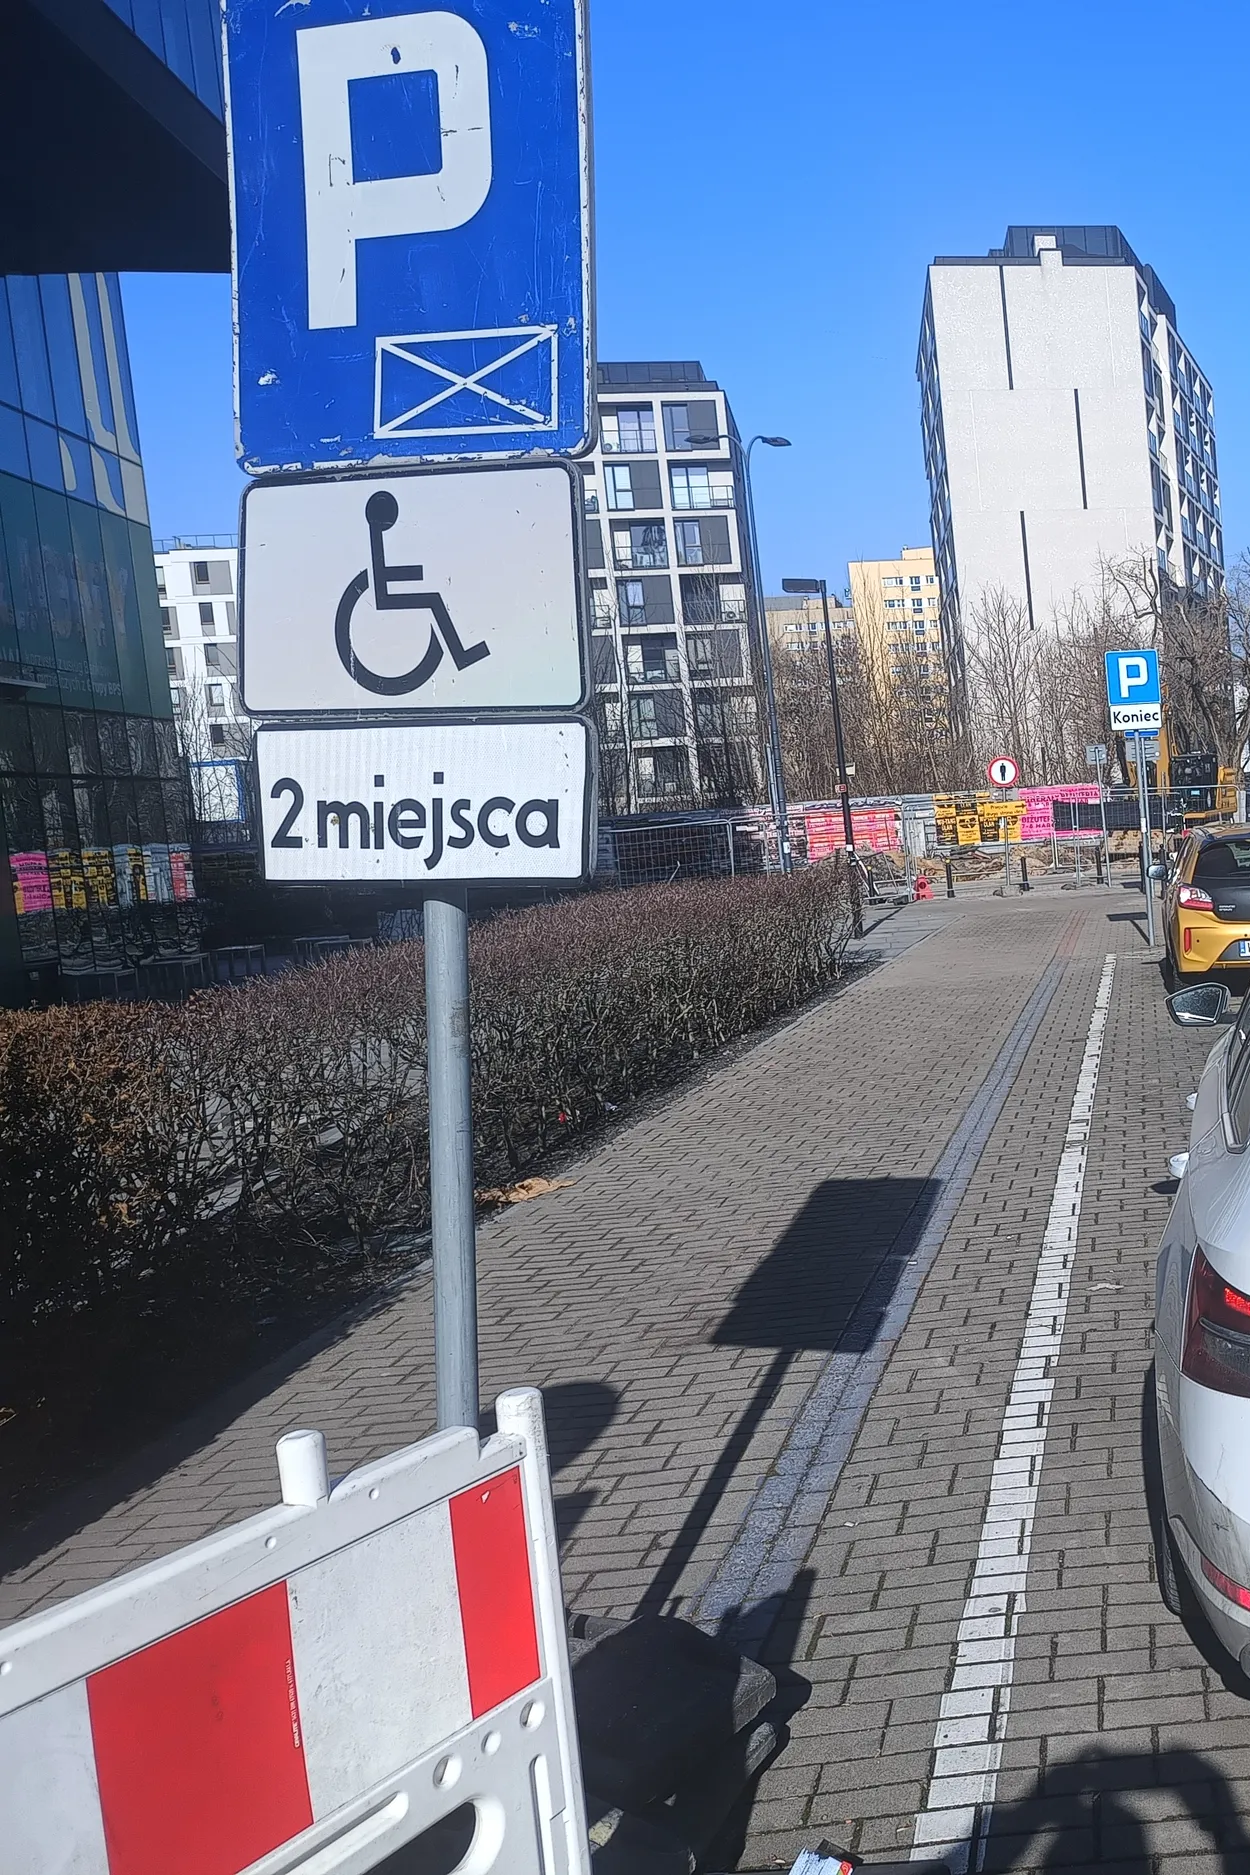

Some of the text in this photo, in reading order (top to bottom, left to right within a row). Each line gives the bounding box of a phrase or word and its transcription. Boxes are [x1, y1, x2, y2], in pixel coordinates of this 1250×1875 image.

[296, 10, 493, 330] P
[1118, 657, 1148, 698] P
[1113, 709, 1159, 724] Koniec
[270, 771, 560, 870] 2 miejsca
